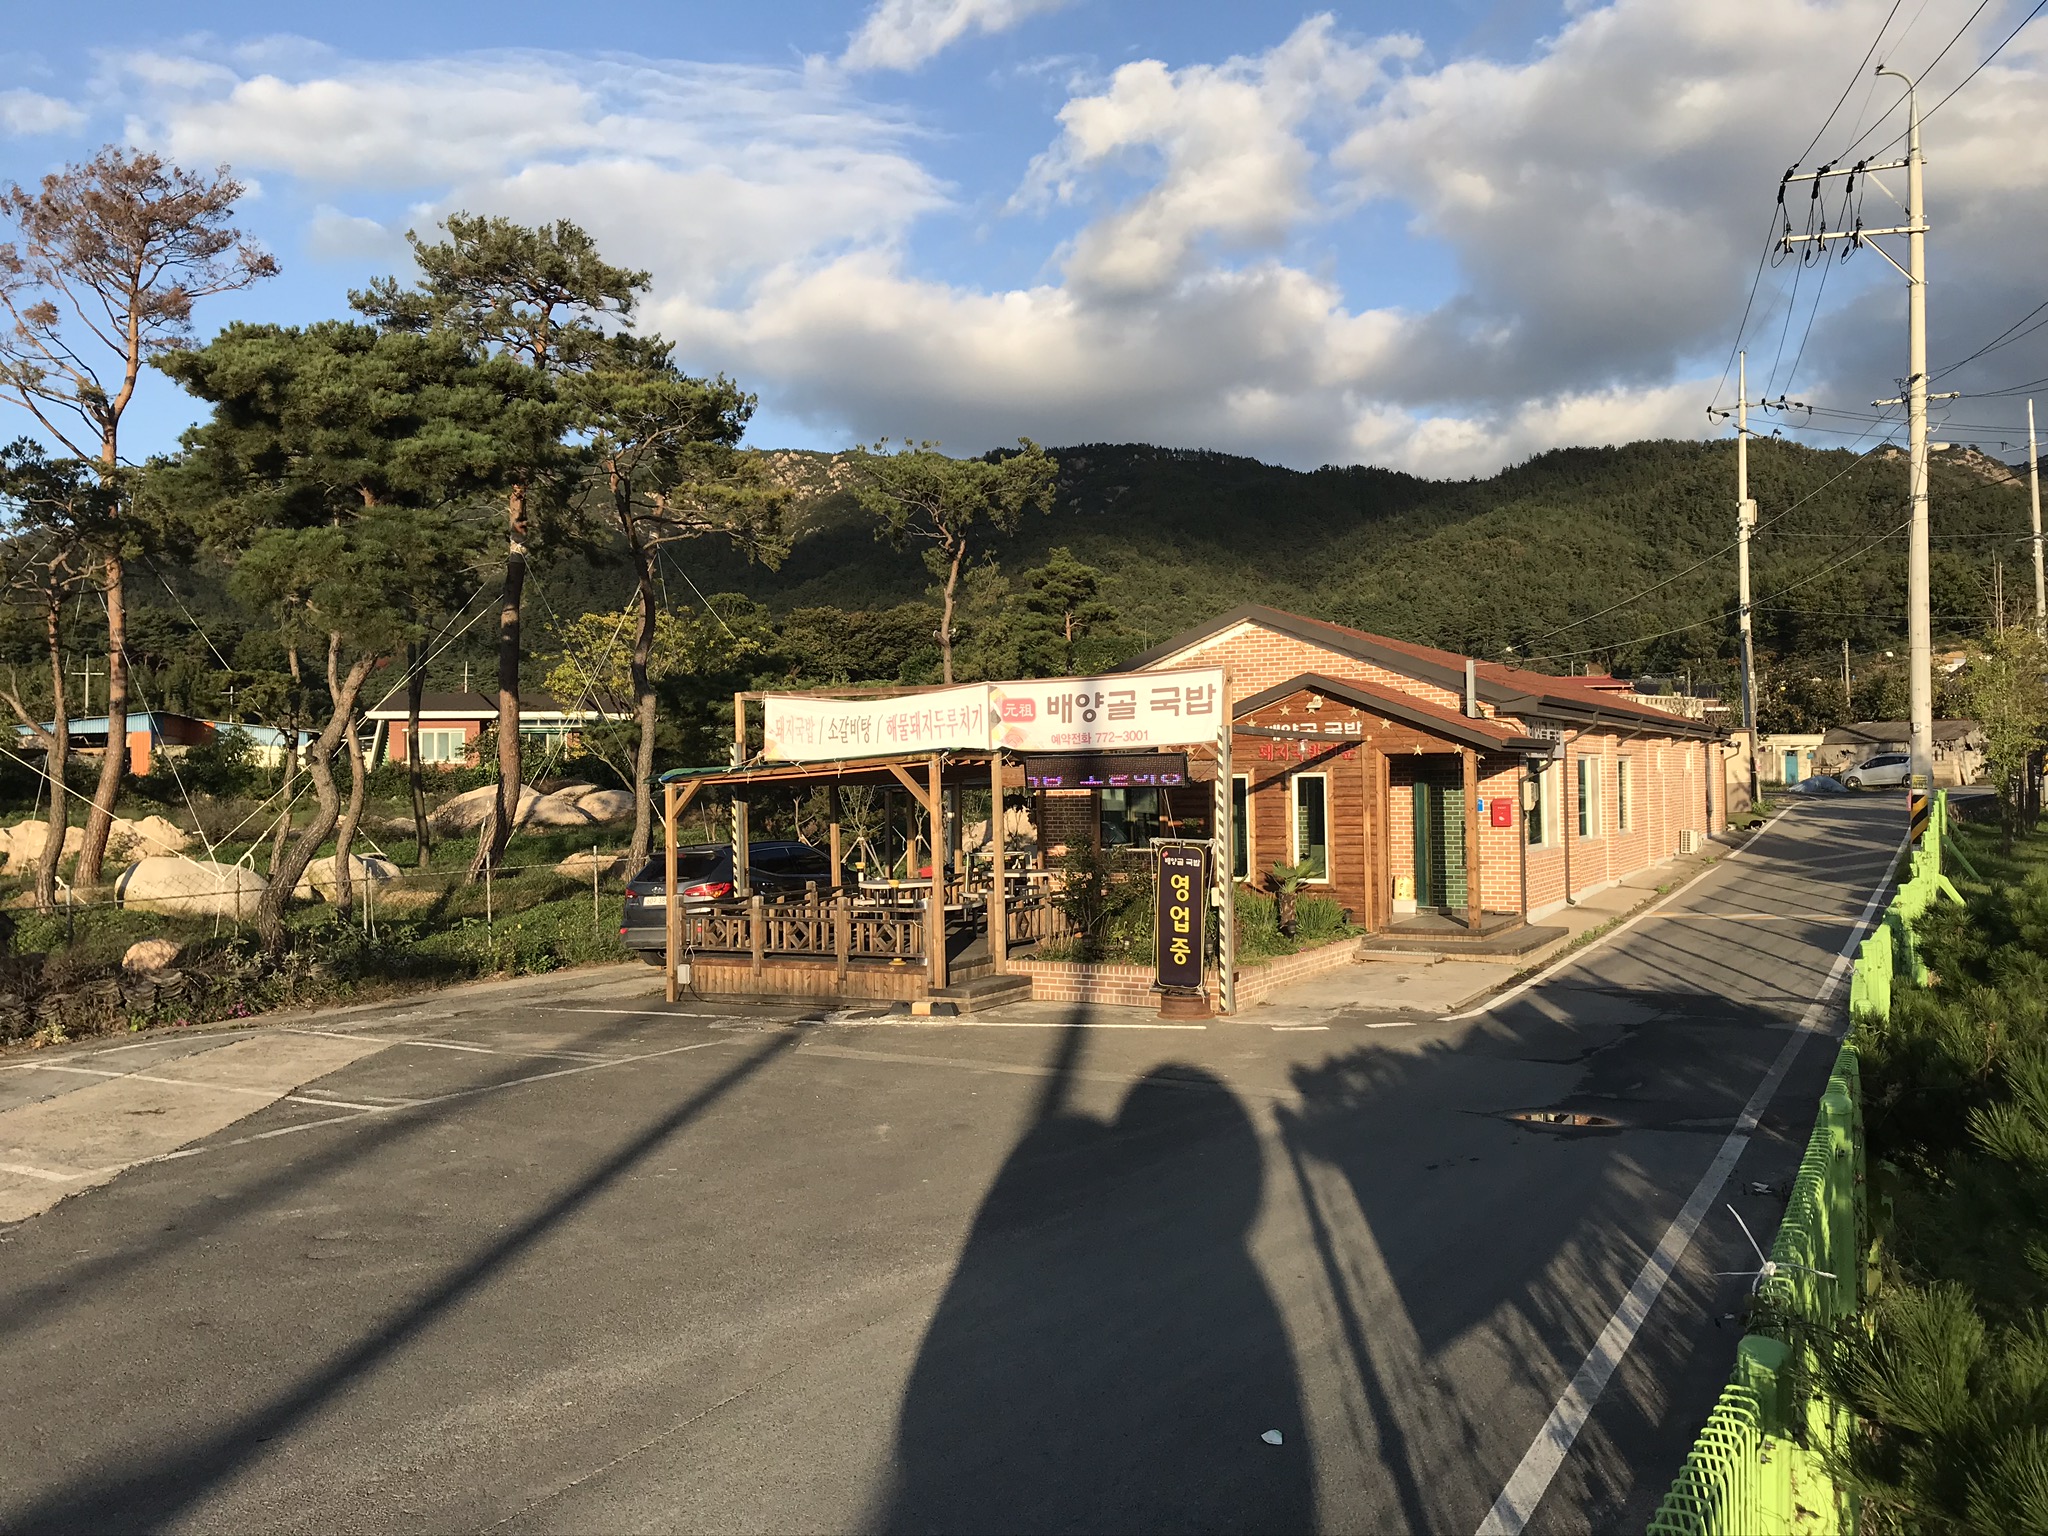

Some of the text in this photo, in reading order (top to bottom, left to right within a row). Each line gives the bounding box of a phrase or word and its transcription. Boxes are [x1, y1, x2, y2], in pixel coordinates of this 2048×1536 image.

[1003, 702, 1034, 718] 元祖
[1047, 683, 1217, 724] 배양골 국밥
[775, 715, 816, 744] 돼지국밥
[828, 714, 872, 744] 소갈비탕
[885, 704, 983, 743] 해물돼지두루치기
[1051, 730, 1149, 746] 예약전화 772-3001
[1164, 857, 1201, 868] 배양골 국밥
[1169, 874, 1191, 965] 영업중
